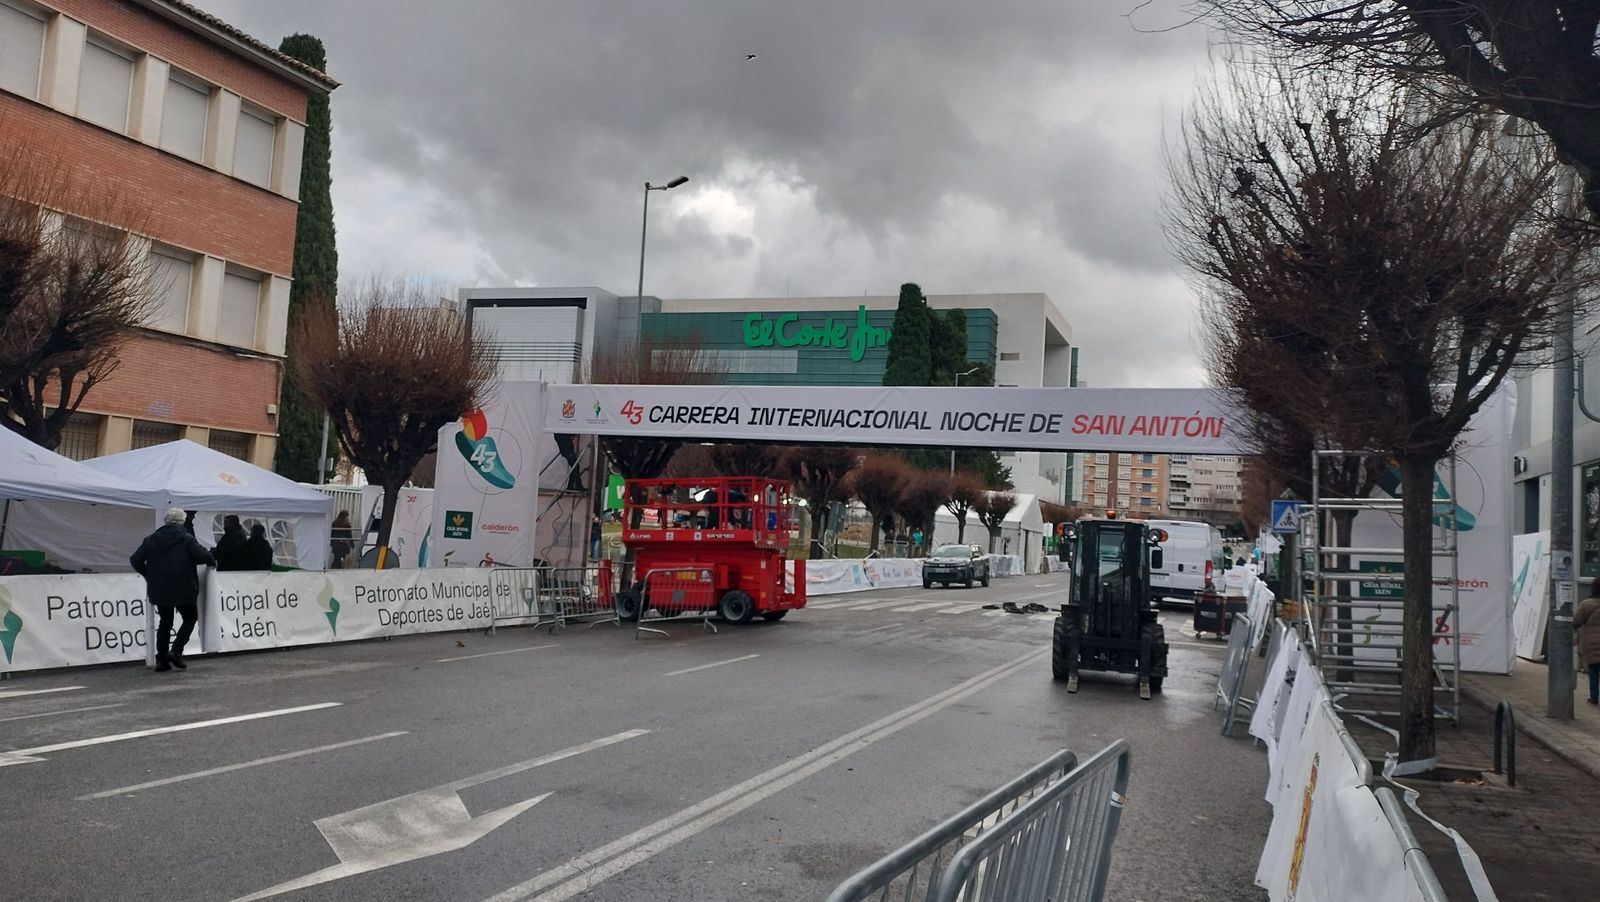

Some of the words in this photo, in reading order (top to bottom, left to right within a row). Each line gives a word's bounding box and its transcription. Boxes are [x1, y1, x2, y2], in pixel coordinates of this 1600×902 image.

[742, 312, 774, 347] El
[774, 313, 847, 349] Corte
[620, 400, 644, 425] 43
[649, 405, 740, 425] CARRERA
[747, 407, 932, 431] INTERNACIONAL
[940, 411, 1025, 433] NOCHE
[1028, 413, 1063, 434] DE
[1071, 414, 1126, 436] SAN
[1128, 410, 1224, 438] ANTÓN
[470, 444, 497, 473] 43
[47, 595, 146, 620] Patrona
[220, 589, 269, 615] icipal
[277, 588, 298, 608] de
[354, 584, 428, 604] Patronato
[432, 580, 490, 600] Municipa
[495, 580, 510, 597] de
[232, 617, 277, 639] Jaén
[378, 607, 443, 629] Deportes
[447, 603, 464, 620] de
